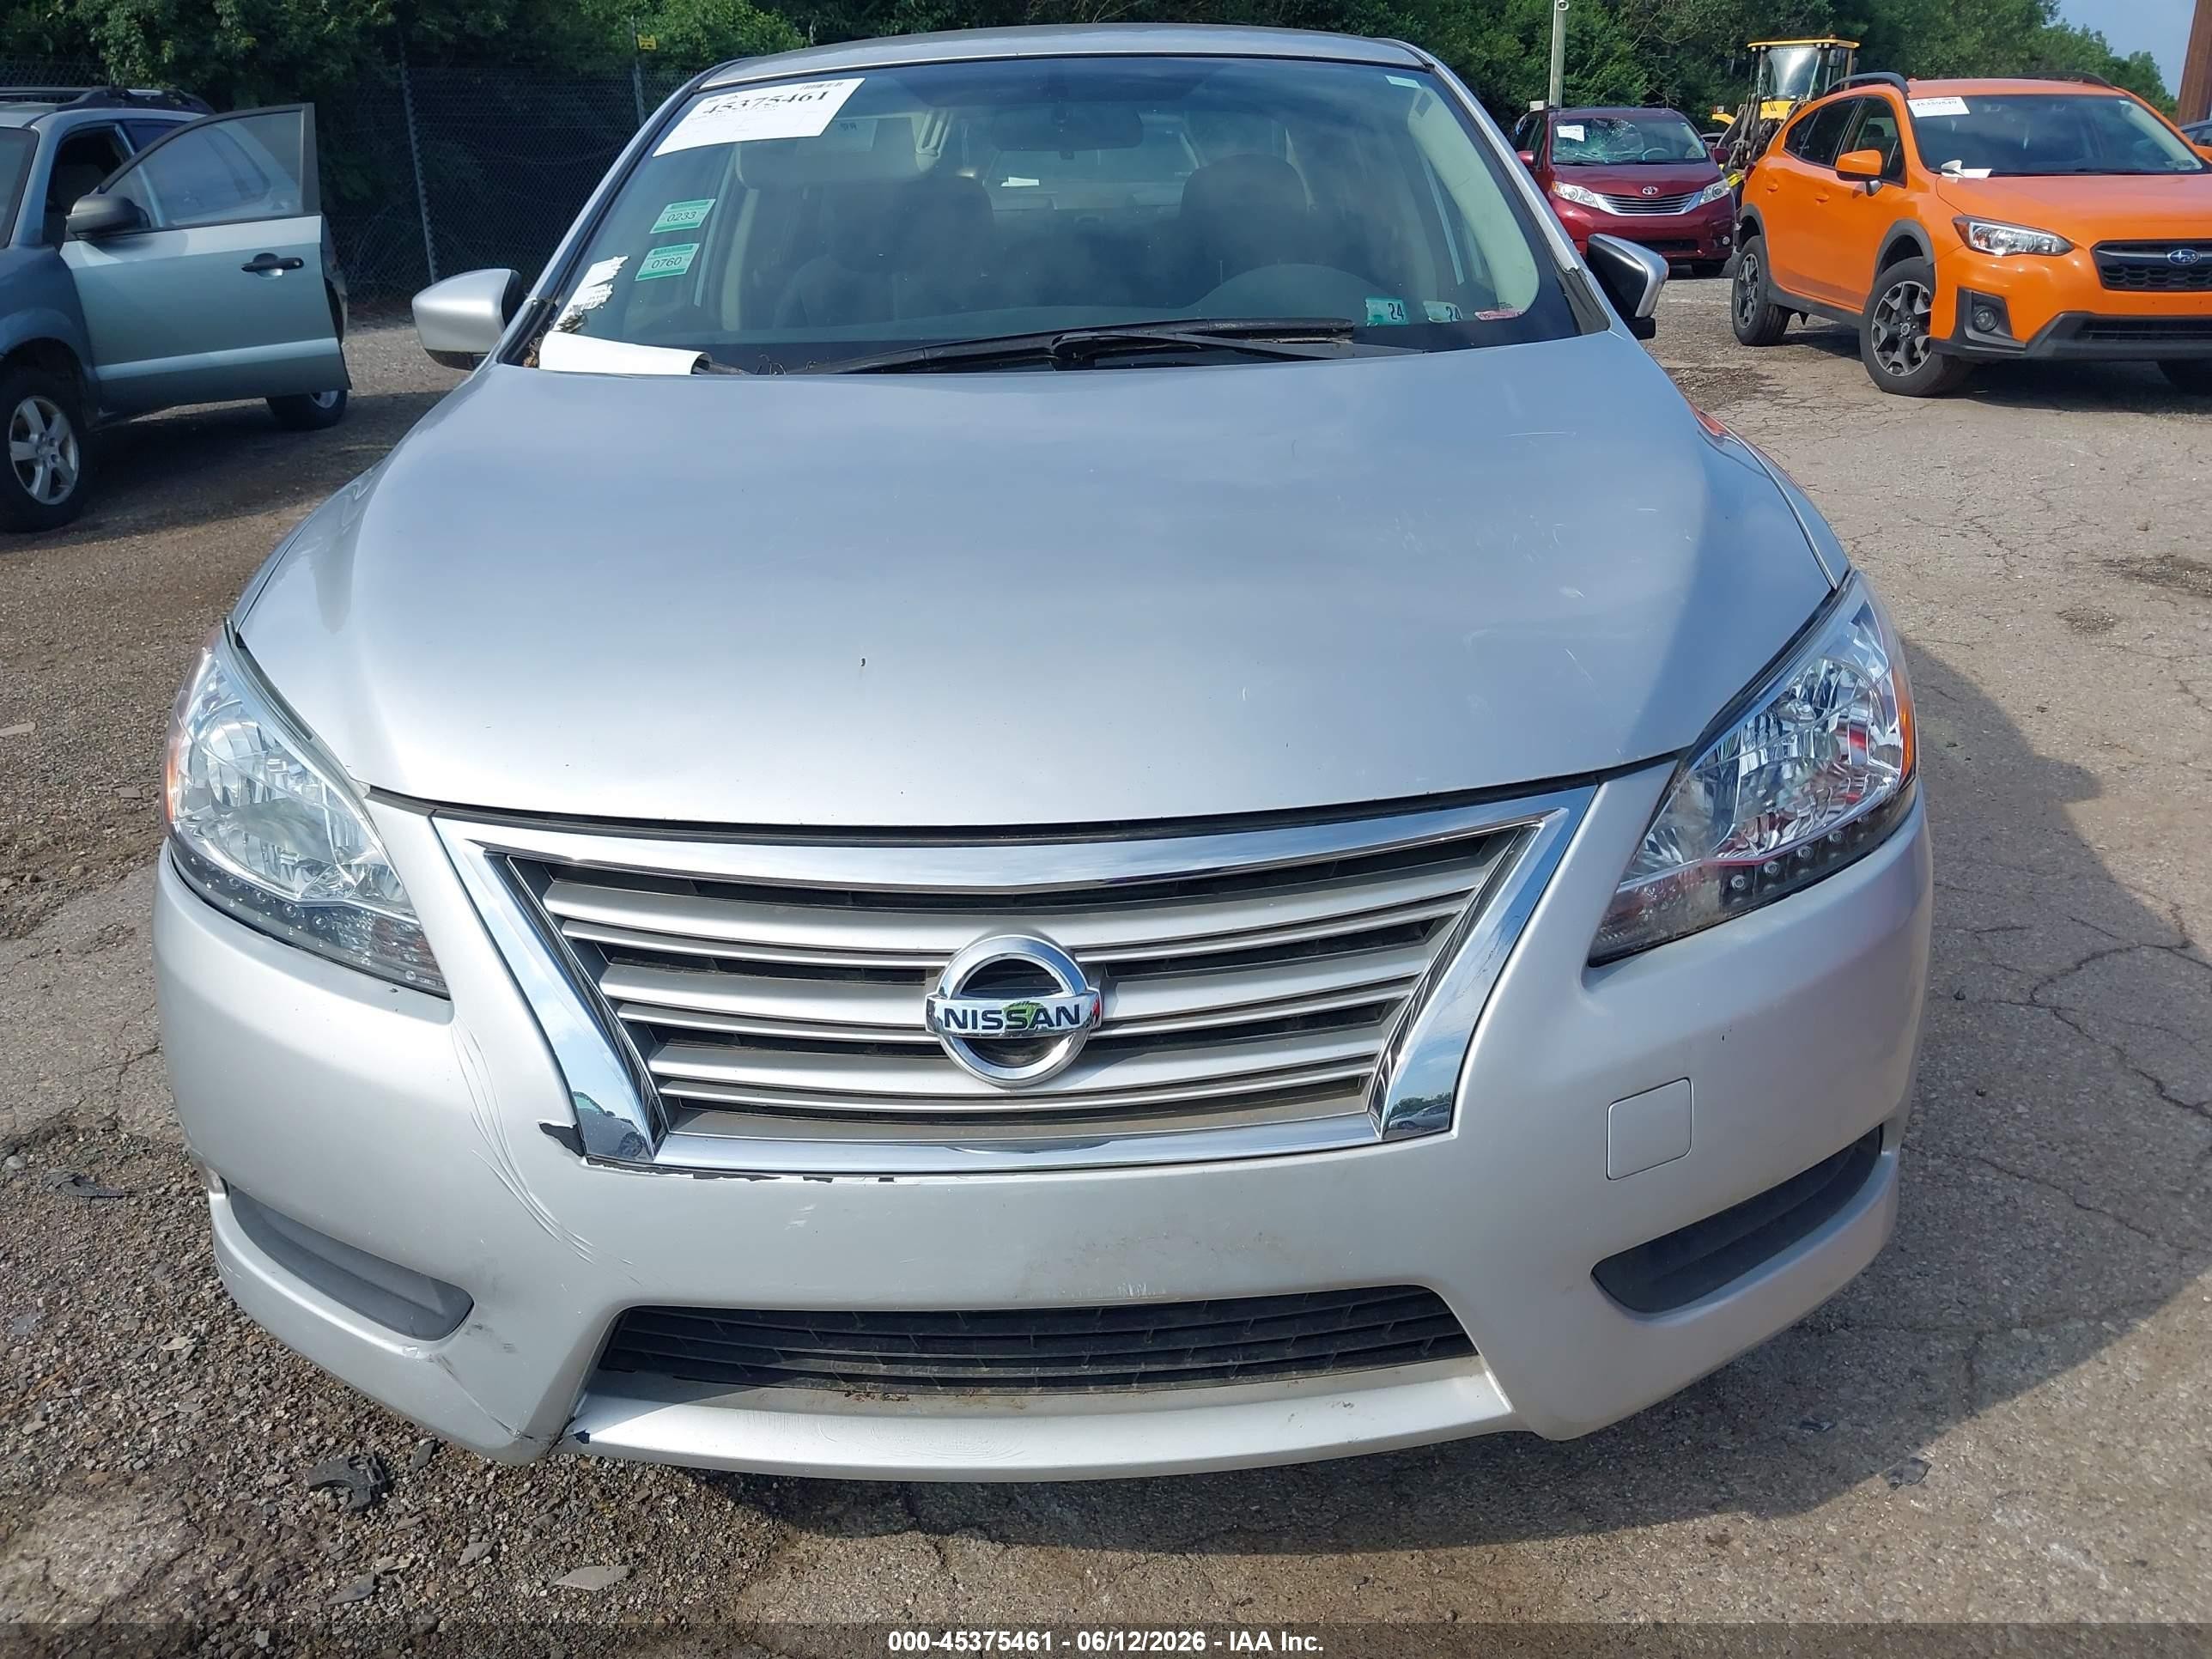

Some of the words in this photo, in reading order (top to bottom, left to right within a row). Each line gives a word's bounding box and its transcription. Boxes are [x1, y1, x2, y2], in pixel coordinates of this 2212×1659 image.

[666, 210, 697, 222] 0233
[651, 256, 683, 269] 0760
[1388, 302, 1405, 320] 24
[944, 1003, 1080, 1030] NISSAN
